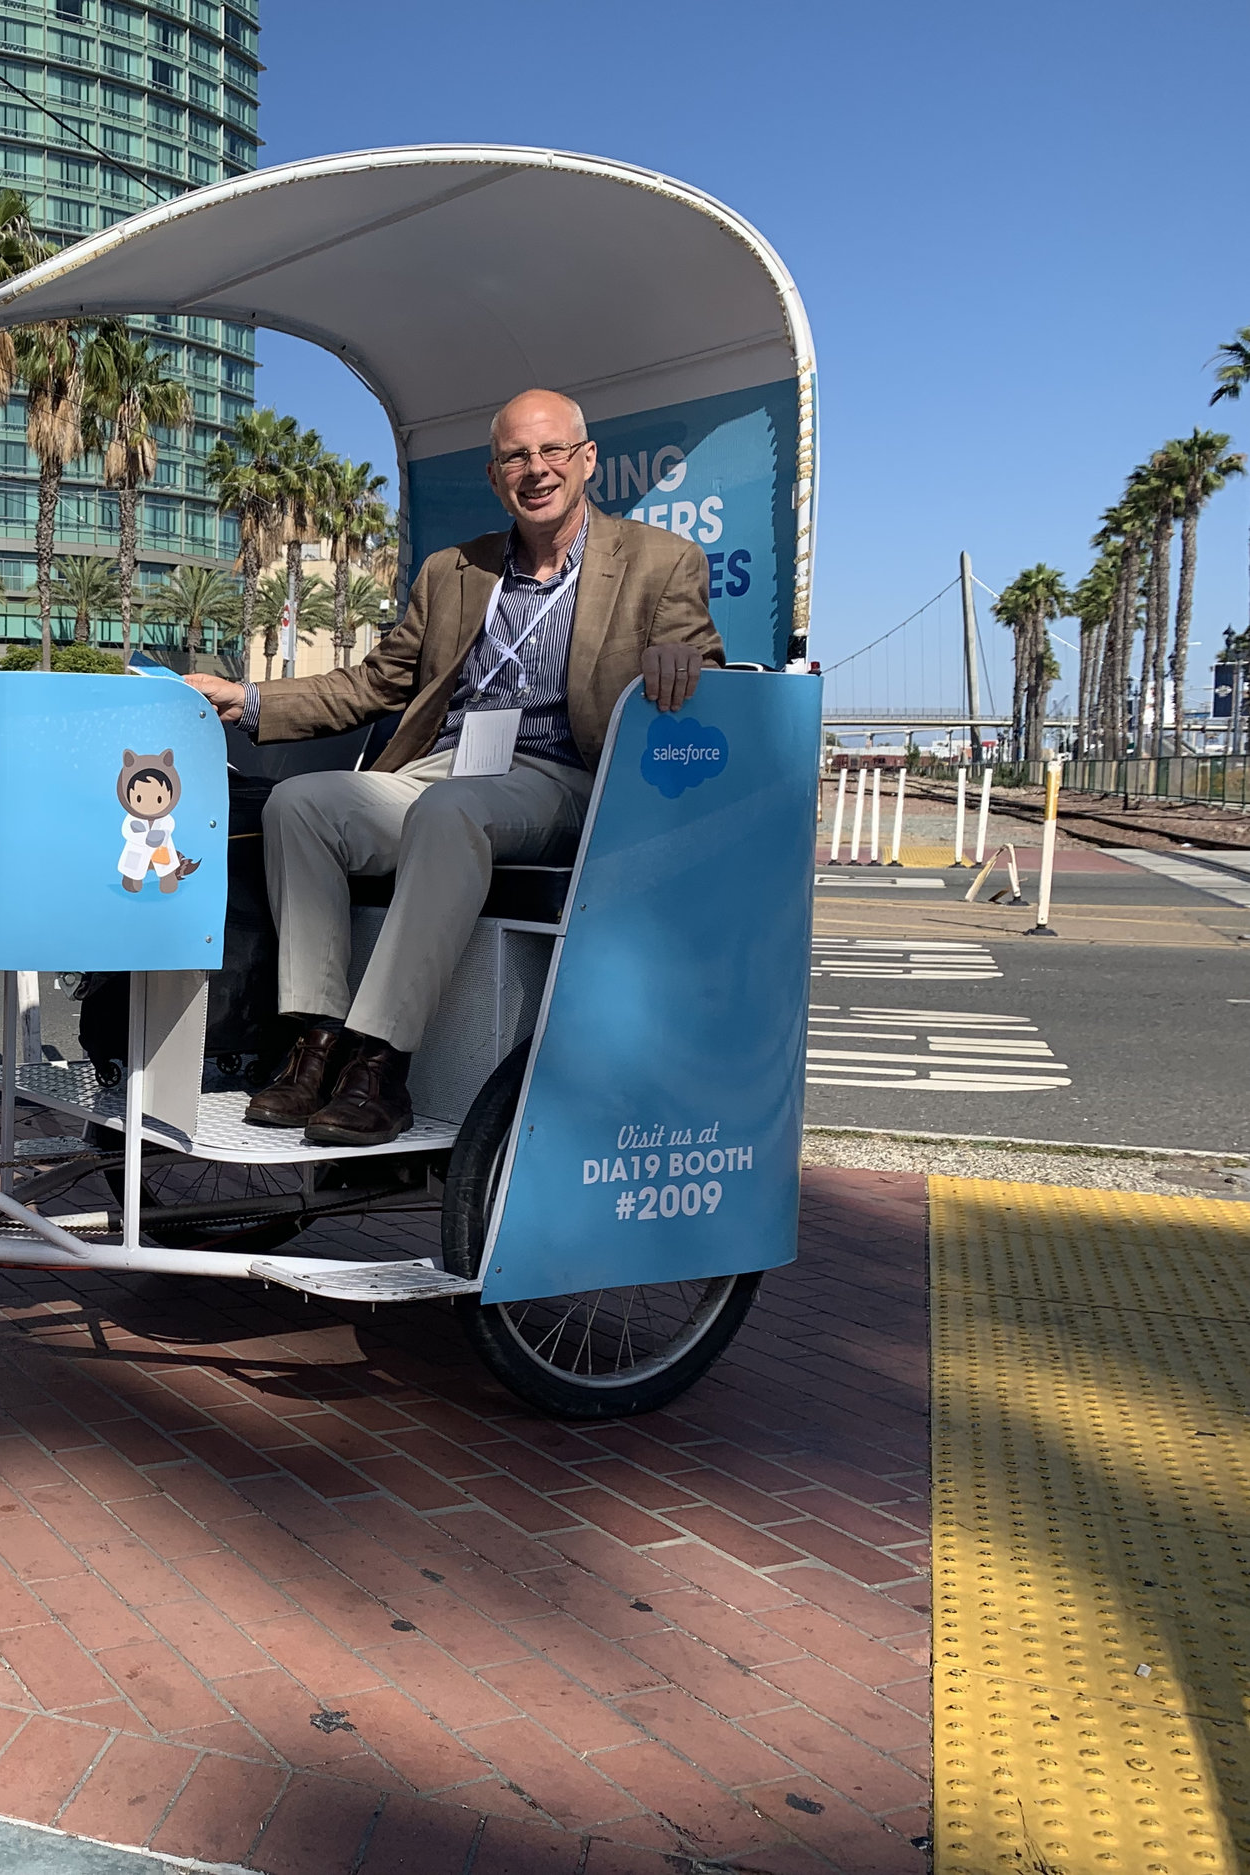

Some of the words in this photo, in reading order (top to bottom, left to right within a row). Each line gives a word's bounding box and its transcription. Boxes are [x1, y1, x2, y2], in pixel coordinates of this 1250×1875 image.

[585, 445, 688, 504] RING
[709, 549, 752, 599] ES
[653, 743, 720, 766] salesforce
[617, 1123, 665, 1150] Visit
[667, 1128, 692, 1146] us
[696, 1121, 720, 1144] at
[583, 1154, 661, 1185] DIA19
[668, 1146, 753, 1177] BOOTH
[615, 1180, 723, 1221] #2009
